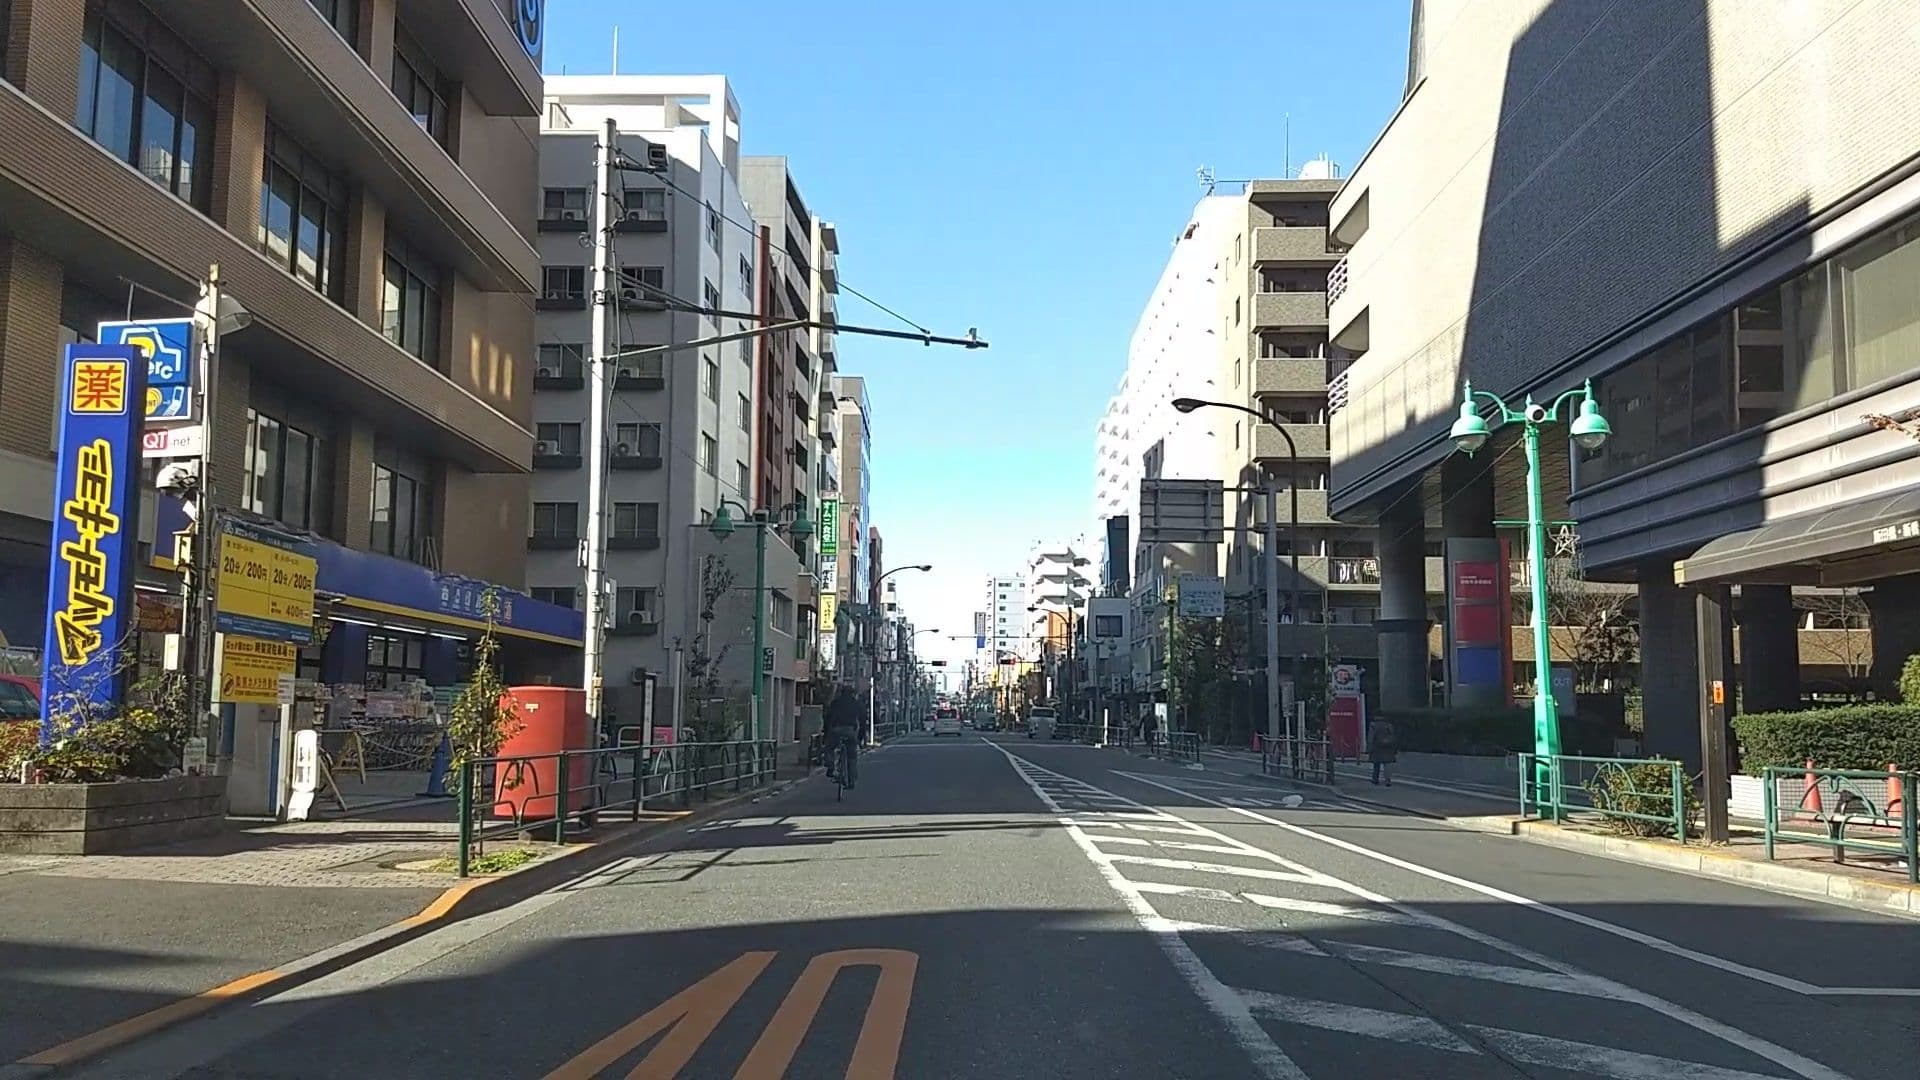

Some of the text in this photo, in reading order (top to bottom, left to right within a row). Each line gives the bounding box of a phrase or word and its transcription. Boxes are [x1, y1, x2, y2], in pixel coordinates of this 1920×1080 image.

[77, 364, 121, 408] 薬
[56, 439, 120, 665] マツモトキヨシ
